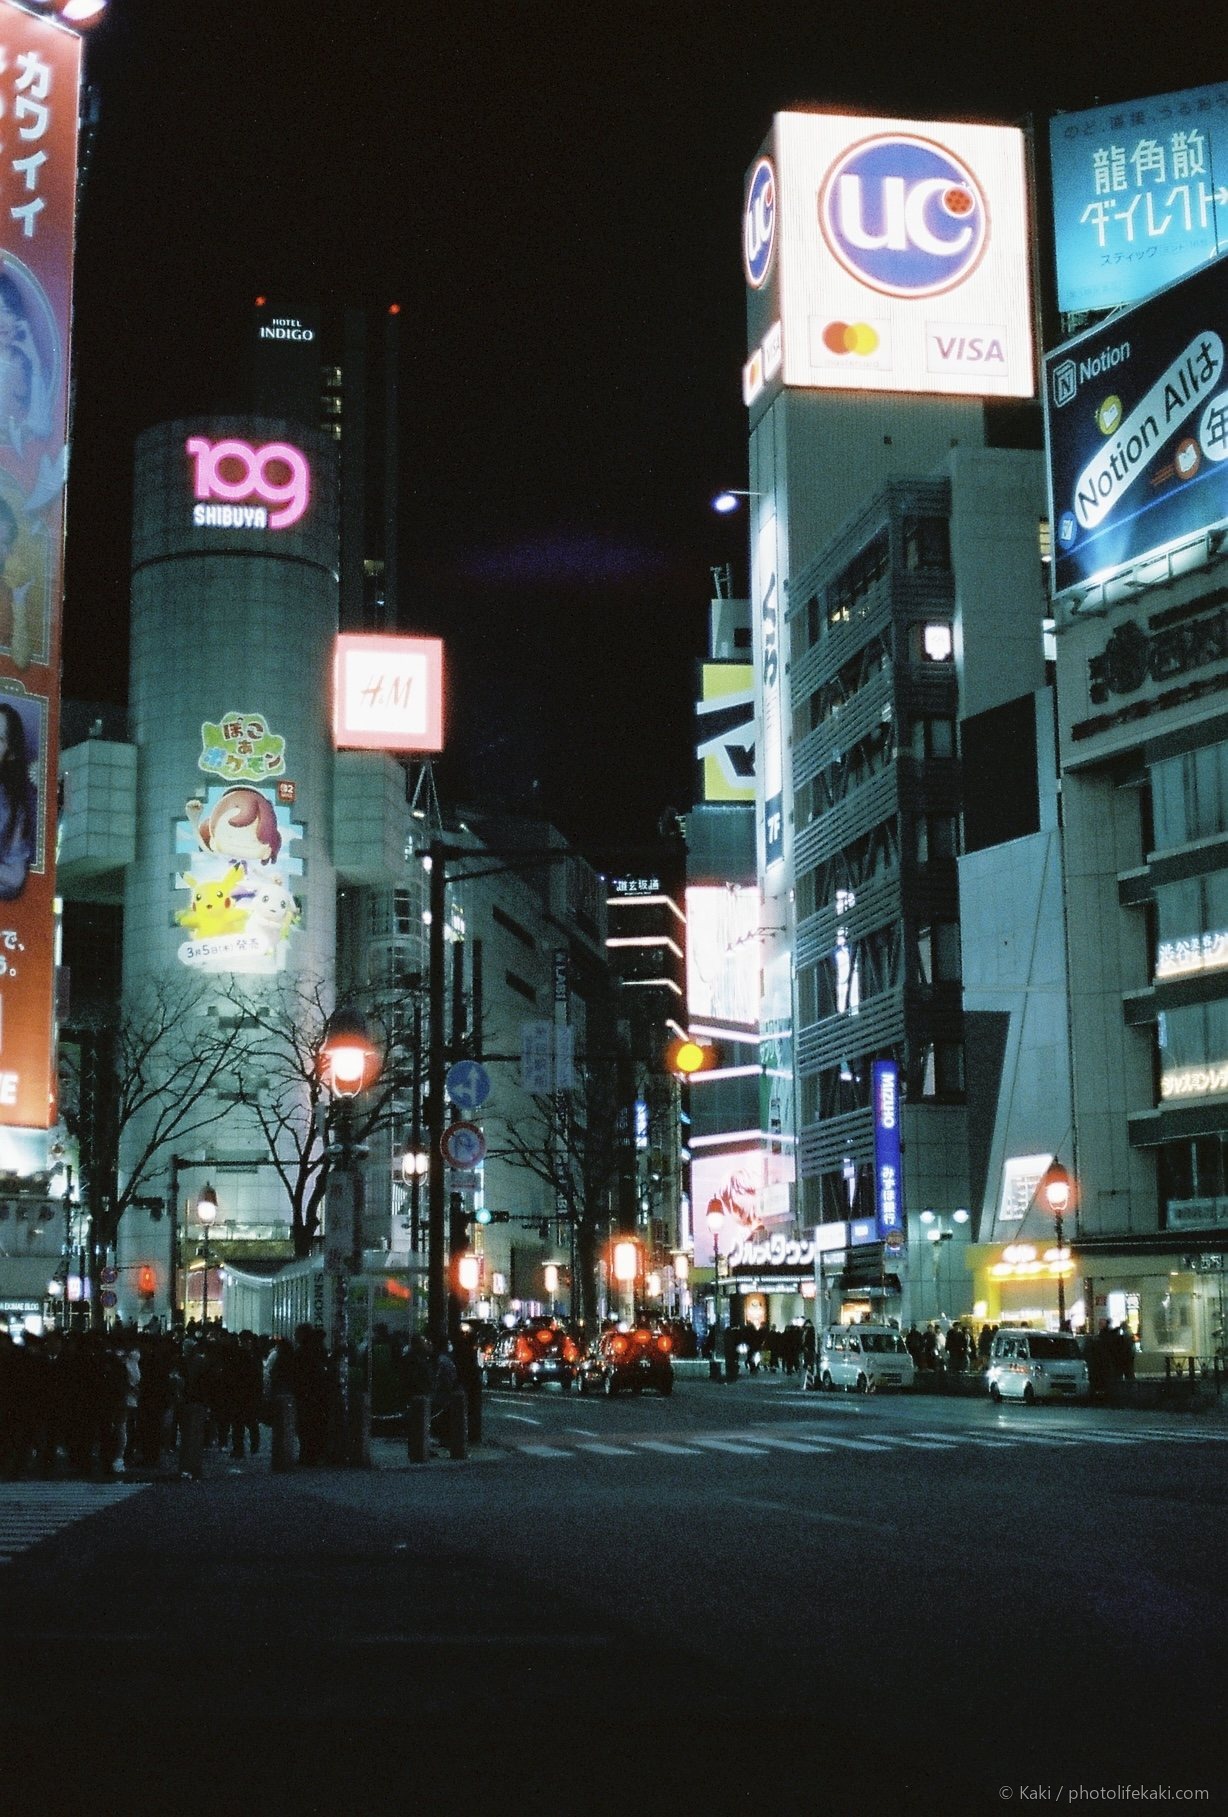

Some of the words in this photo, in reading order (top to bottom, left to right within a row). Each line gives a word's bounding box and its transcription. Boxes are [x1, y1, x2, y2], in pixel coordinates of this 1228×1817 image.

[11, 51, 50, 238] カワイイ
[1093, 128, 1207, 195] 龍角散
[1080, 181, 1228, 247] ダイレクト
[259, 326, 314, 341] INDIGO
[272, 318, 302, 327] HOTEL
[934, 336, 1005, 363] VISA
[1079, 340, 1131, 385] Notion
[187, 437, 310, 530] 109
[1078, 414, 1159, 522] Notion
[193, 503, 268, 529] SHIBUYA
[882, 1072, 896, 1129] MIZUHO
